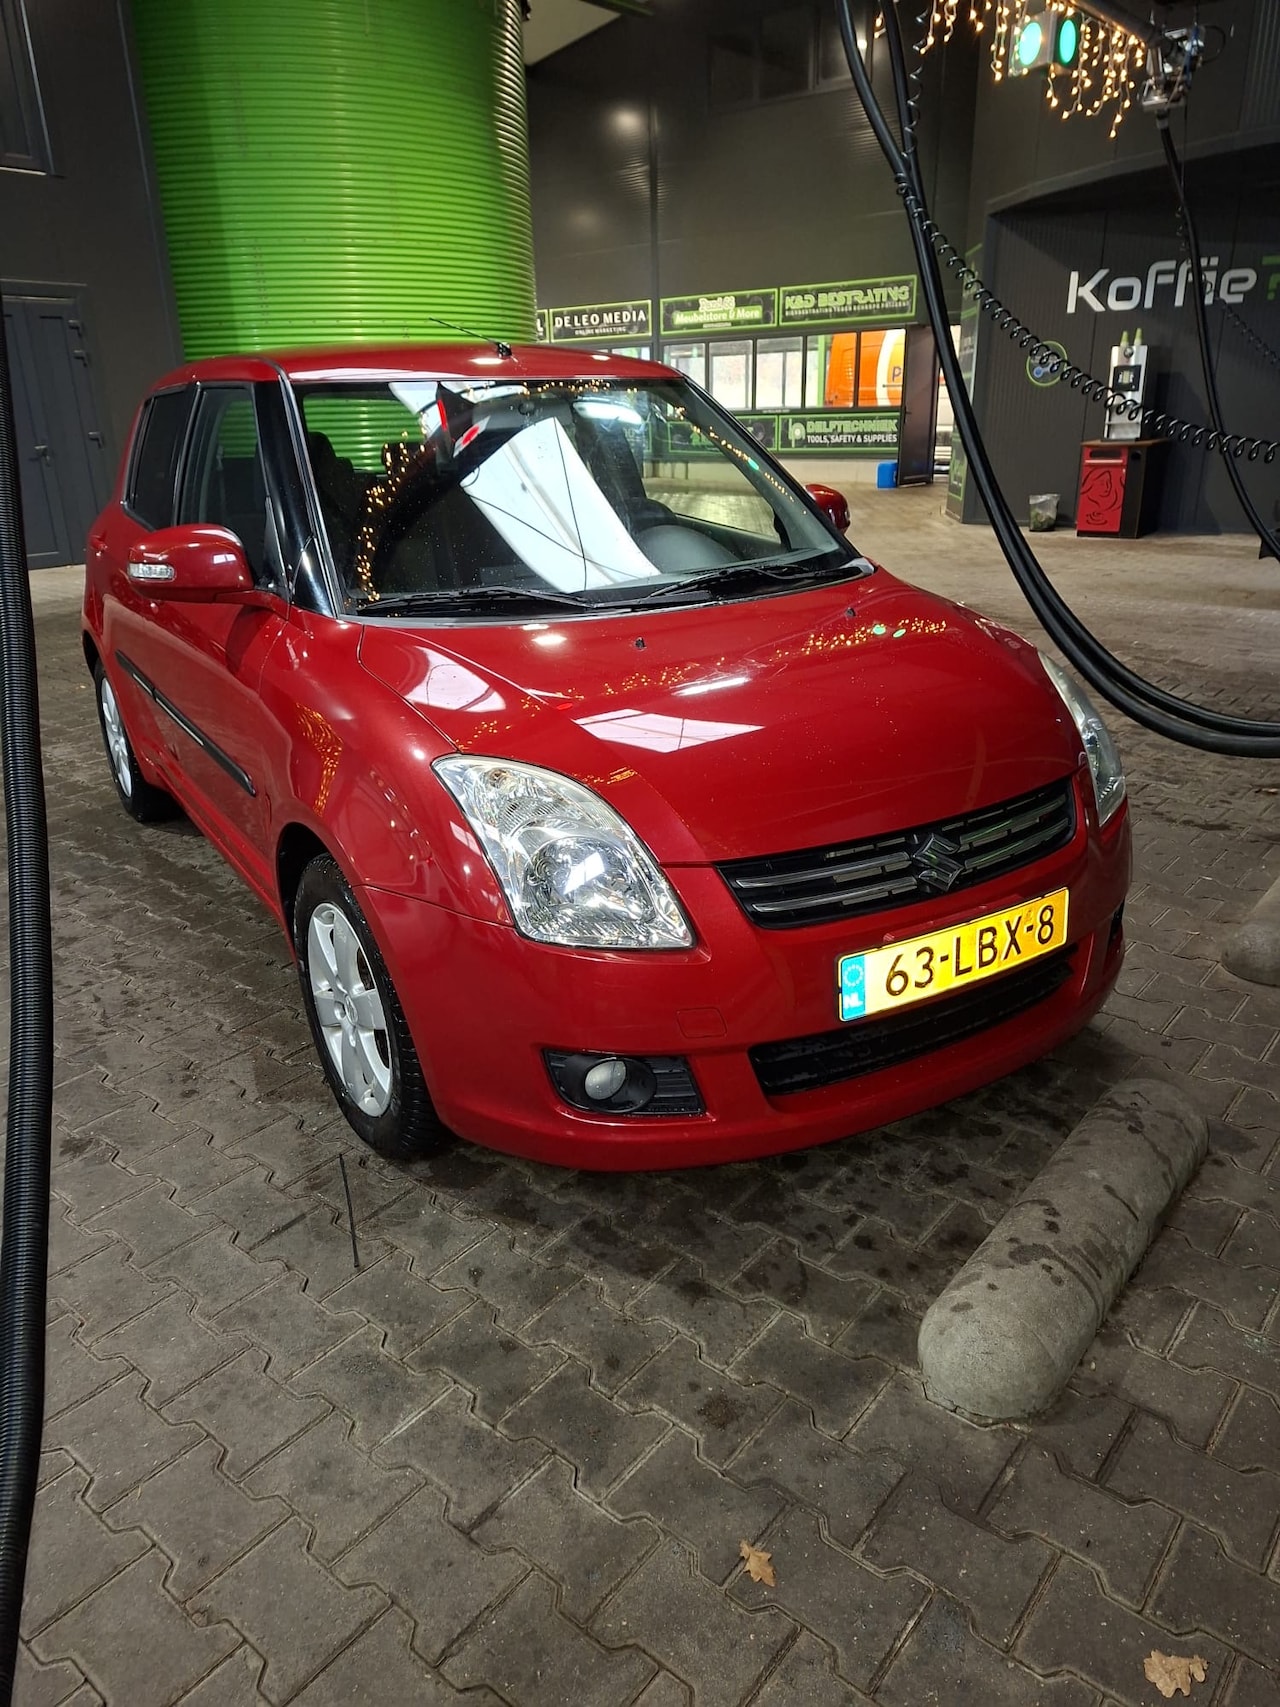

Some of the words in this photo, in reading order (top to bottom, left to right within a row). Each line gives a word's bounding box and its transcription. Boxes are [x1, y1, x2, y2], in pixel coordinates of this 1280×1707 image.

[1067, 256, 1258, 314] Koffie
[818, 285, 909, 307] BESTRATING
[554, 316, 572, 328] DE
[574, 313, 601, 326] LEO
[603, 309, 647, 324] MEDIA
[675, 309, 728, 325] Meubelstore
[737, 306, 760, 319] More
[595, 326, 627, 334] MARKETING
[807, 434, 829, 445] TOOLS,
[830, 434, 856, 443] SAFETY
[856, 434, 862, 443] &
[863, 433, 898, 443] SUPPLIES
[886, 905, 1054, 996] 63-LBX-8
[843, 993, 863, 1010] NL
